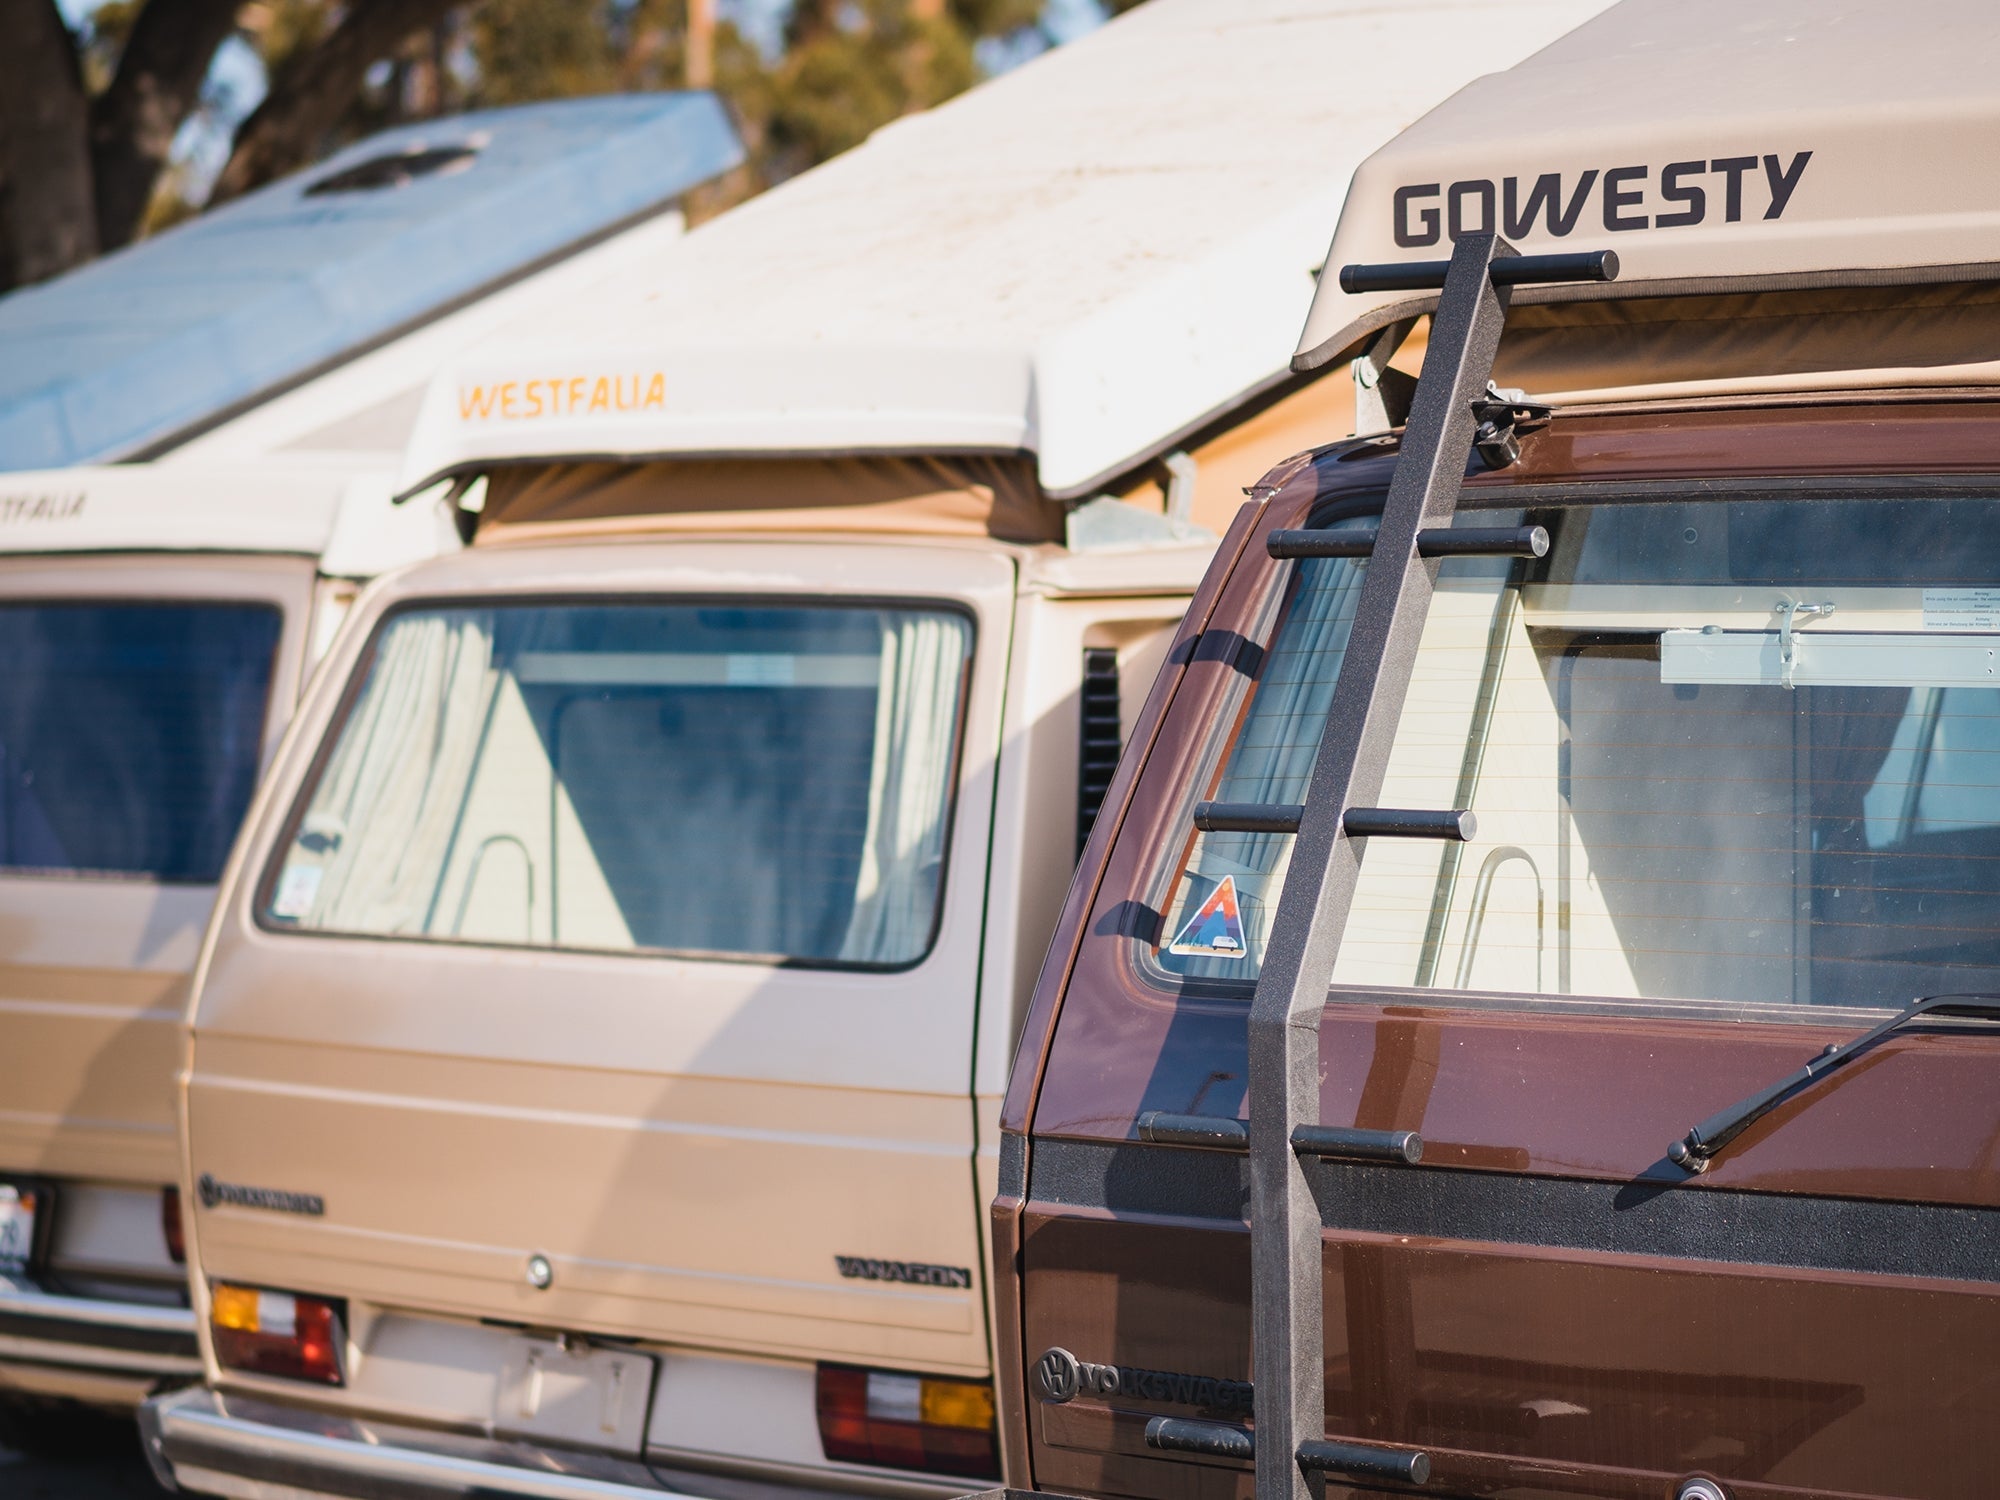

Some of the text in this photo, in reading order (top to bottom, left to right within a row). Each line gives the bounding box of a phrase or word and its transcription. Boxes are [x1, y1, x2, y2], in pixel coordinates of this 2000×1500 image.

[1393, 151, 1813, 248] GOWESTY
[459, 372, 666, 421] WESTFALIA
[834, 1254, 972, 1290] VANAGON
[1080, 1361, 1254, 1409] VOLKSWAGE
